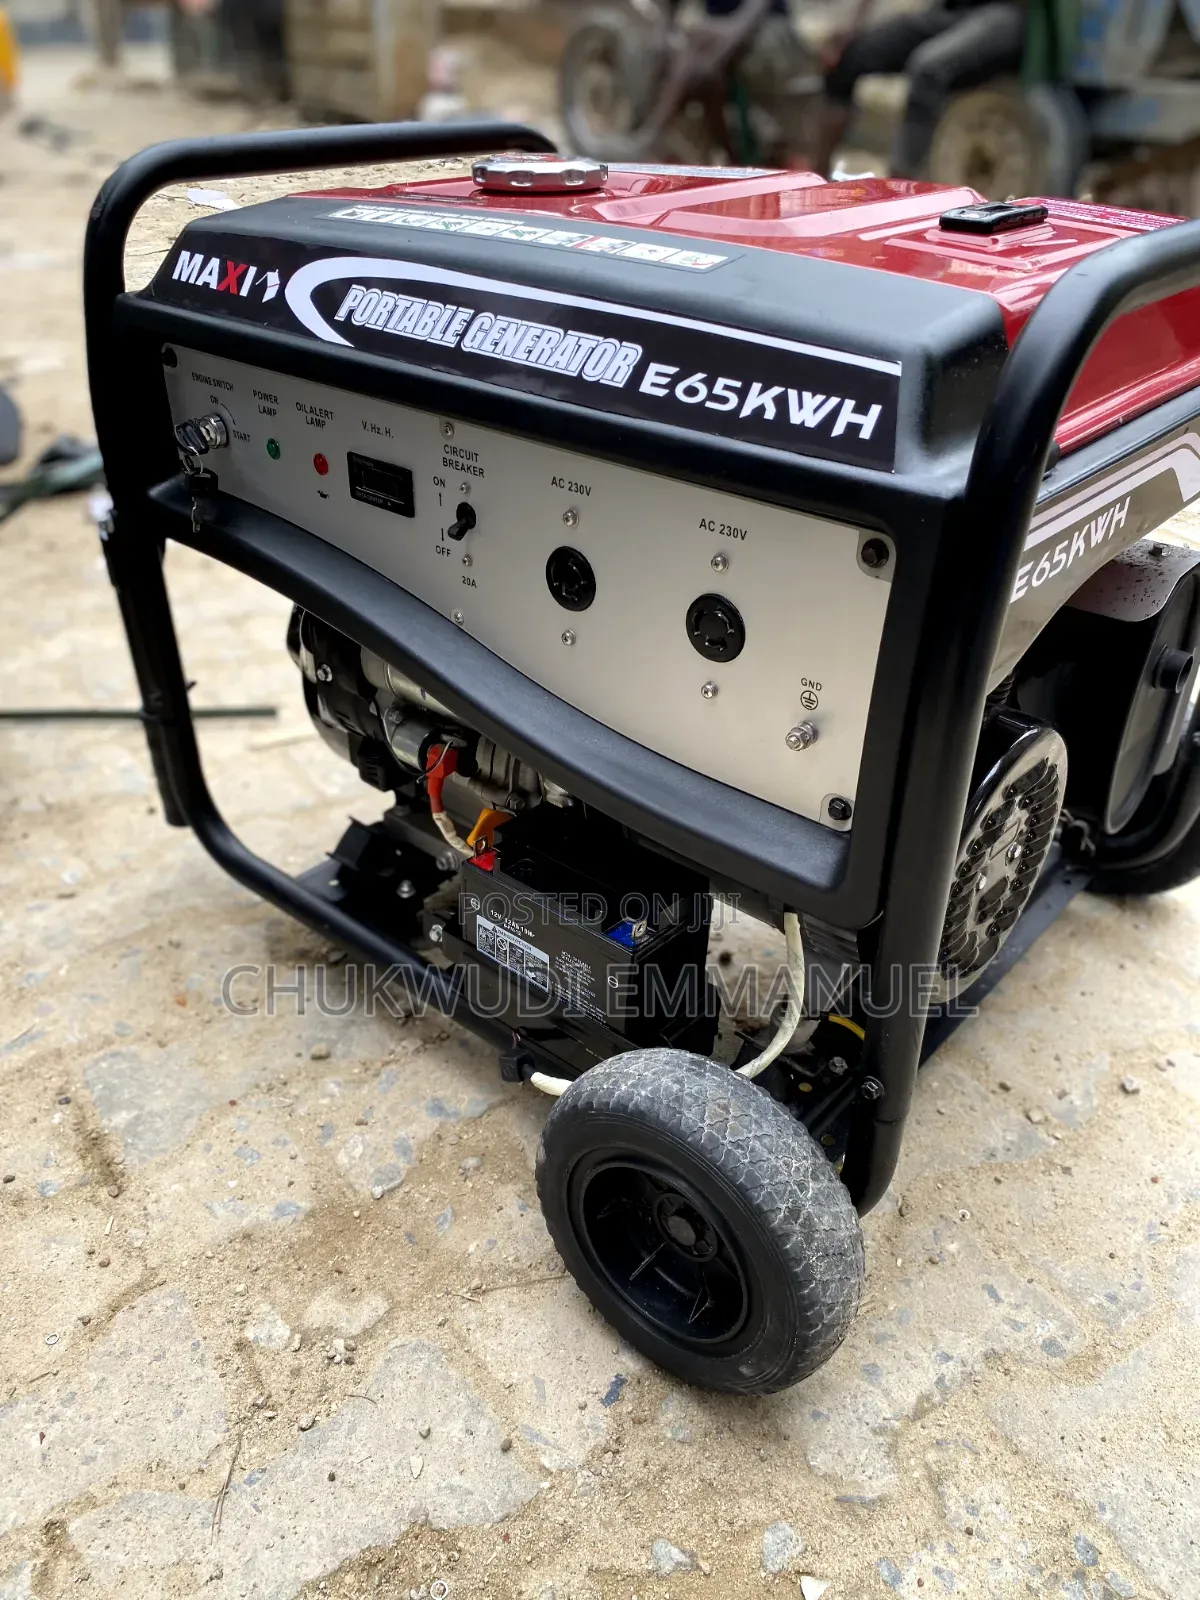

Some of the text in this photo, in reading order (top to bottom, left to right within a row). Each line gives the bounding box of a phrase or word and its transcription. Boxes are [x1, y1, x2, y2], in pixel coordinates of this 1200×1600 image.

[171, 250, 257, 298] MAXI
[334, 284, 883, 441] PORTABLE GENERATOR E65KWH
[191, 372, 234, 391] ENGINE SWITCH
[210, 394, 219, 404] ON
[252, 389, 279, 405] POWER
[258, 404, 277, 417] LAMP
[295, 402, 334, 420] OIL ALERT
[305, 415, 326, 429] LAMP
[233, 430, 251, 443] START
[443, 444, 480, 463] CIRCUIT
[442, 457, 485, 478] BREAKER
[433, 476, 446, 489] ON
[550, 475, 592, 497] AC 230V
[699, 517, 748, 541] AC 230V
[435, 545, 451, 558] OFF
[1010, 496, 1132, 604] E65KWH
[461, 576, 477, 588] 20A
[801, 676, 823, 692] GND
